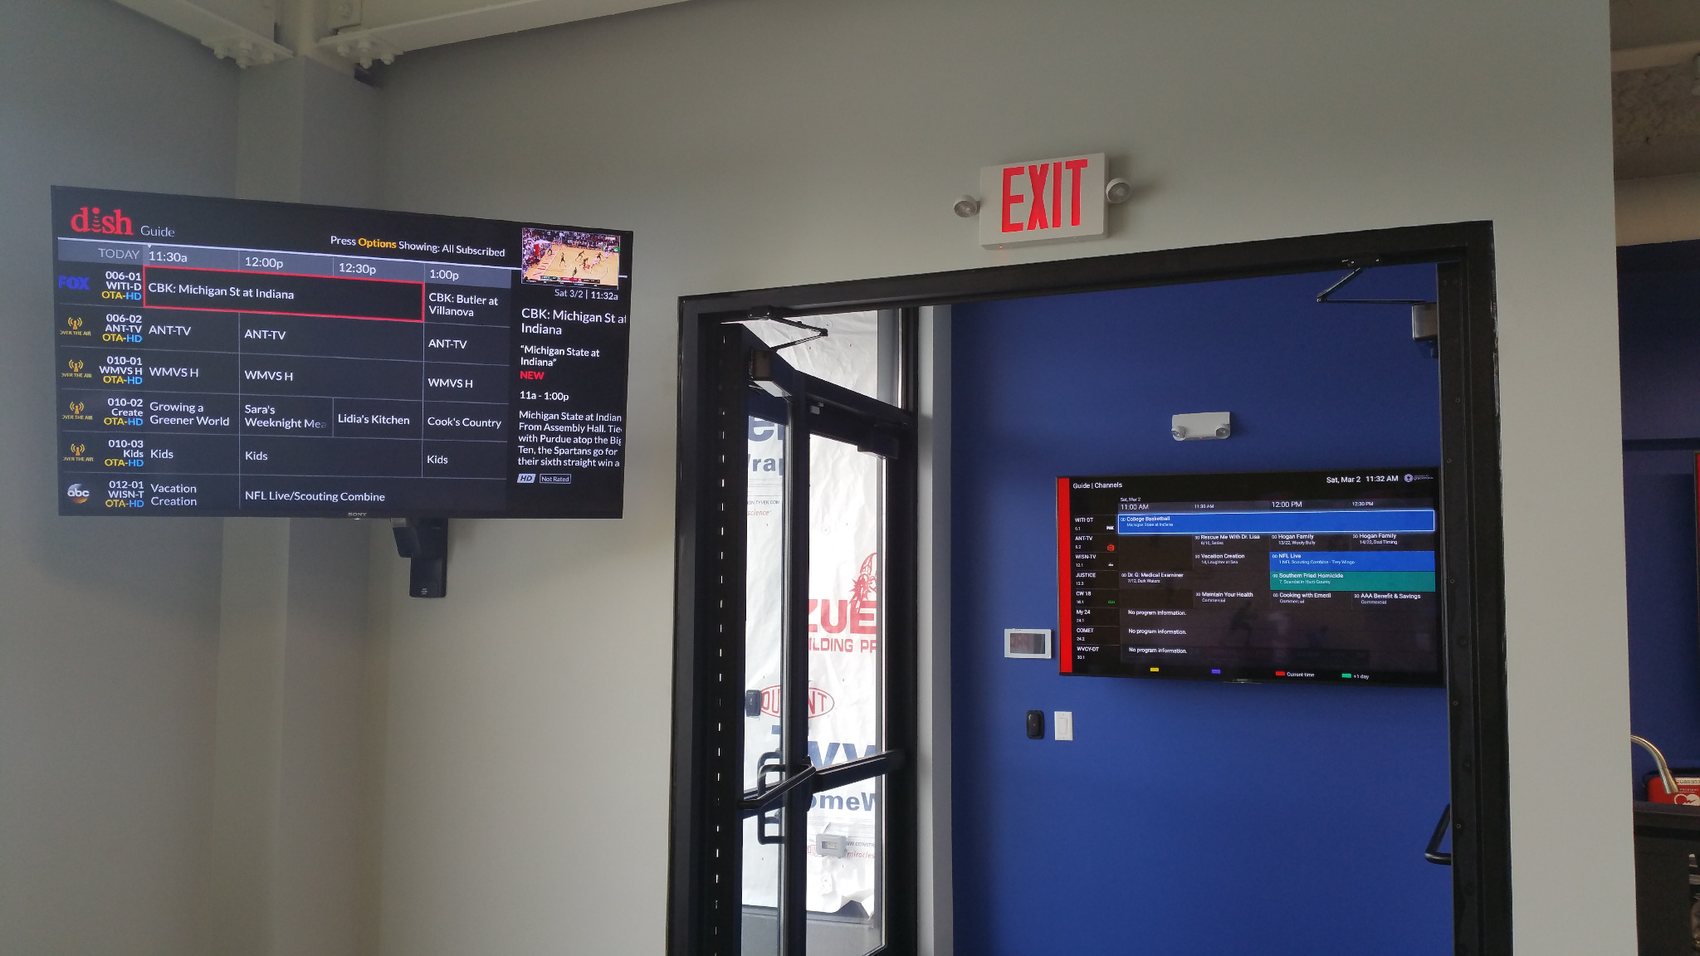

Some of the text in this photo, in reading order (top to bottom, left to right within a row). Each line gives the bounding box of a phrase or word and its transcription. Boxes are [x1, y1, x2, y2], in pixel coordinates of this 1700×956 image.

[1002, 159, 1088, 232] EXIT
[70, 207, 134, 236] dish
[140, 225, 175, 237] Guide
[330, 236, 505, 257] Press Options Showing: All Subscribed
[98, 248, 140, 259] TODAY
[148, 251, 188, 263] 11:30a
[245, 257, 283, 269] 12:00p
[339, 263, 376, 275] 12:30p
[430, 269, 459, 280] 1:00p
[105, 271, 141, 281] 006-01
[58, 275, 90, 290] FOX
[106, 281, 142, 291] WITI-D
[101, 291, 142, 301] OTA-HD
[148, 282, 294, 299] CBK: Michigan St at Indiana
[554, 288, 618, 300] Sat 3/2 11:32a
[429, 293, 498, 306] CBK: Butler at
[429, 306, 474, 317] Villanova
[521, 308, 550, 320] CBK:
[553, 310, 602, 324] Michigan
[604, 314, 615, 323] St
[106, 314, 142, 323] 006-02
[105, 323, 142, 333] ANT-TV
[148, 325, 191, 336] ANT-TV
[521, 324, 562, 335] Indiana
[102, 333, 142, 343] OTA-HD
[244, 329, 286, 340] ANT-TV
[428, 338, 467, 350] ANT-TV
[566, 348, 588, 357] State
[590, 349, 600, 357] at
[106, 356, 142, 366] 010-01
[99, 366, 142, 375] WMVS H
[149, 367, 199, 377] WMVS H
[245, 370, 293, 382] WMVS H
[520, 371, 544, 380] NEW
[103, 375, 142, 385] OTA-HD
[428, 378, 473, 389] WMVS H
[519, 391, 569, 402] 11a 1:00p
[107, 398, 143, 407] 010-02
[150, 402, 196, 414] Growing
[111, 408, 143, 417] Create
[245, 404, 275, 415] Sara's
[104, 417, 143, 426] OTA-HD
[150, 415, 230, 426] Greener World
[338, 414, 410, 425] Lidia's Kitchen
[519, 411, 559, 421] Michigan
[561, 412, 583, 421] State
[245, 418, 302, 429] Weeknight
[427, 417, 502, 428] Cook's Country
[519, 422, 542, 432] From
[543, 423, 585, 434] Assembly
[587, 424, 605, 433] Hall.
[108, 439, 143, 448] 010-03
[518, 434, 538, 444] with
[540, 435, 571, 444] Purdue
[573, 436, 592, 446] atop
[594, 436, 608, 444] the
[123, 449, 144, 458] Kids
[150, 449, 174, 459] Kids
[245, 451, 268, 461] Kids
[518, 446, 618, 457] Ten, the Spartans go for
[104, 458, 144, 467] OTA-HD
[427, 455, 448, 465] Kids
[518, 457, 539, 466] their
[541, 457, 561, 467] sixth
[564, 458, 596, 469] straight
[598, 458, 613, 467] win
[521, 474, 532, 482] HD
[541, 475, 570, 483] Not Rated
[109, 480, 144, 490] 012-01
[151, 483, 197, 493] Vacation
[67, 488, 89, 498] abc
[108, 490, 144, 499] WISN-T
[245, 491, 385, 503] NFL Live/Scouting Combine
[105, 499, 144, 508] OTA-HD
[151, 496, 197, 506] Creation
